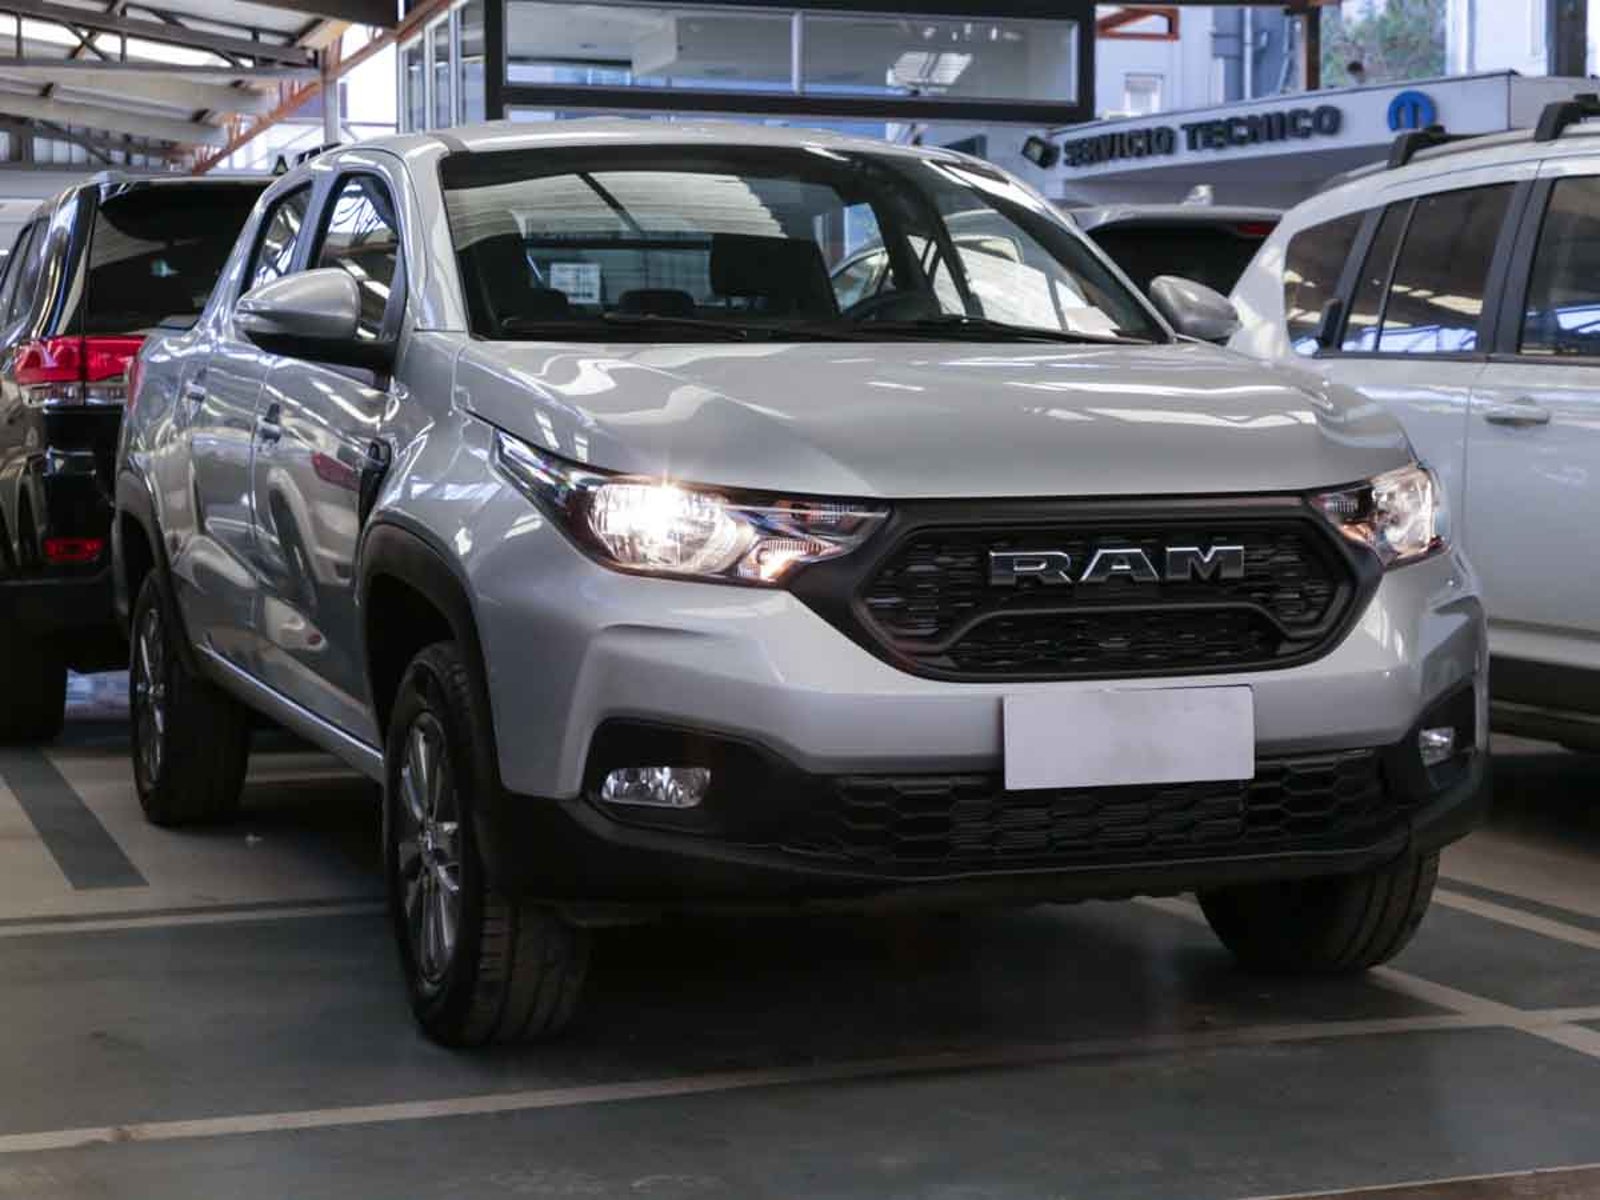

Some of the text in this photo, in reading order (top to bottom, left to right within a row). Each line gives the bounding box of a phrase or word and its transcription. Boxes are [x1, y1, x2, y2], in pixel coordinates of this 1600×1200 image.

[1064, 105, 1341, 166] SERVICIO TECNICO
[989, 546, 1245, 584] RAM
